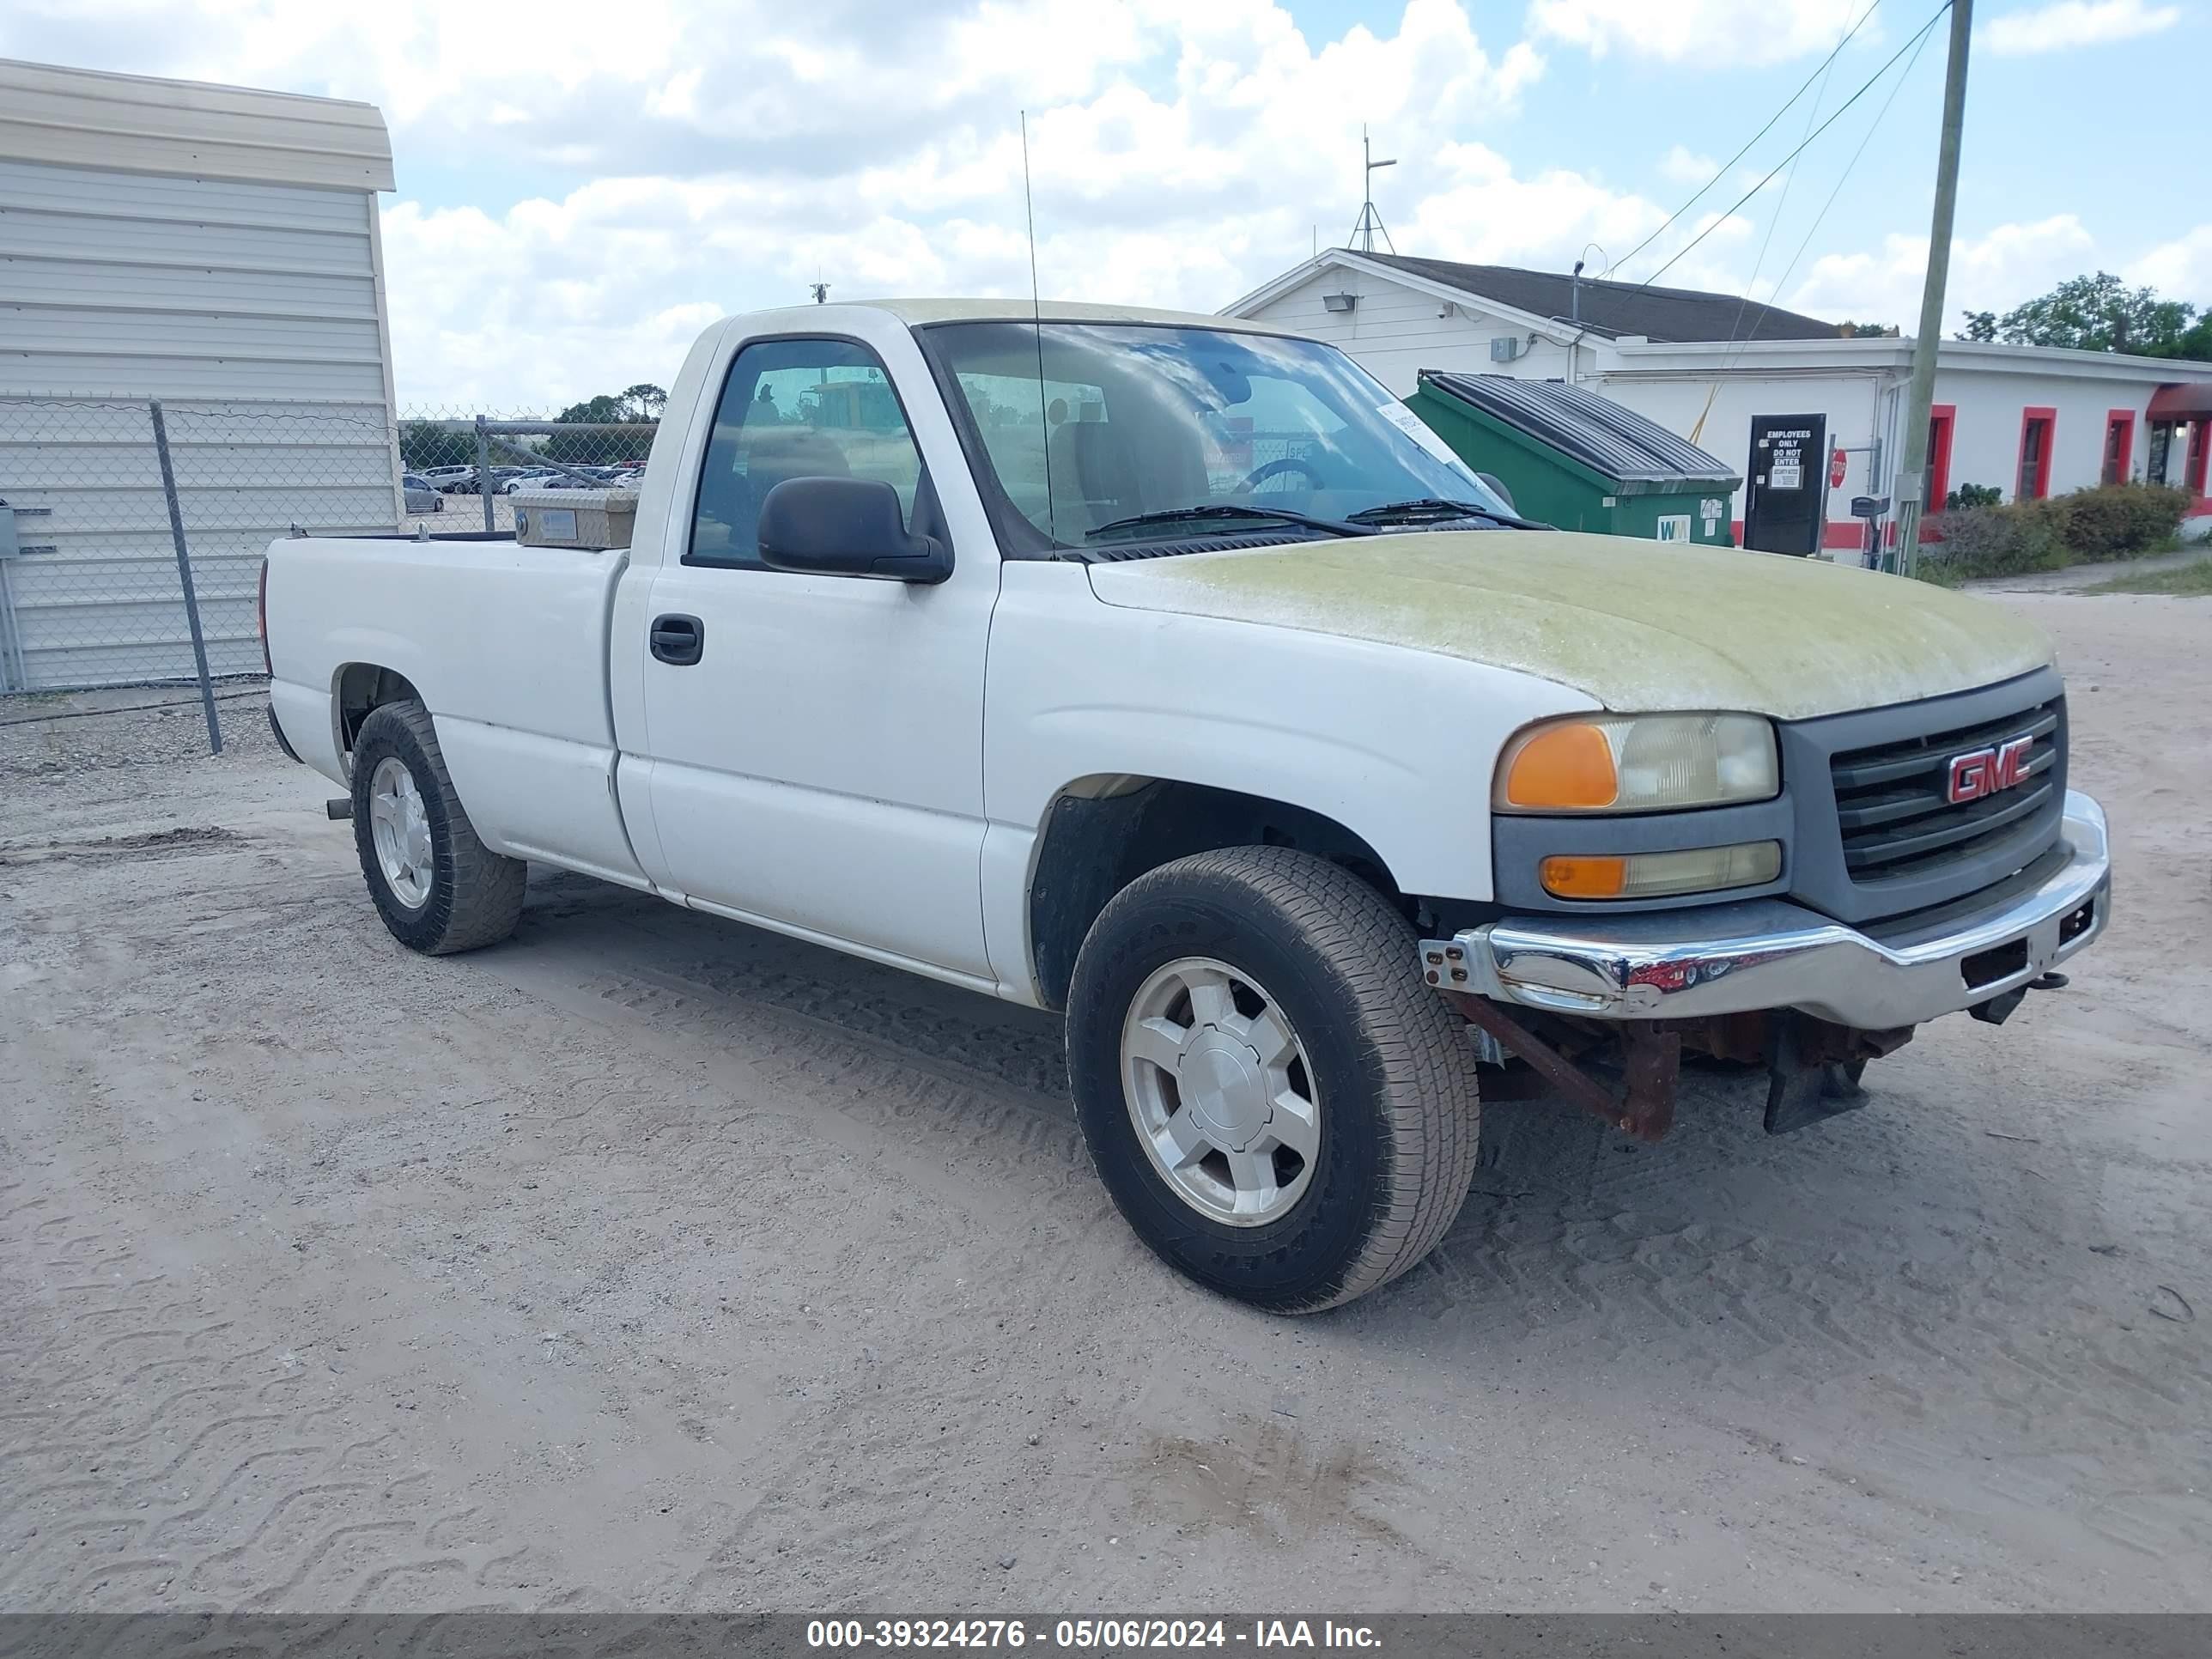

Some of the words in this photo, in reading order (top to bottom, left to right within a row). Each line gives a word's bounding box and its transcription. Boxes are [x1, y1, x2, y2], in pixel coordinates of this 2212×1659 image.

[1767, 430, 1811, 439] EMPLOYEES
[1775, 458, 1800, 466] ENTER
[1832, 460, 1846, 477] STOP
[1661, 521, 1686, 540] WM
[1948, 734, 2034, 804] GMC
